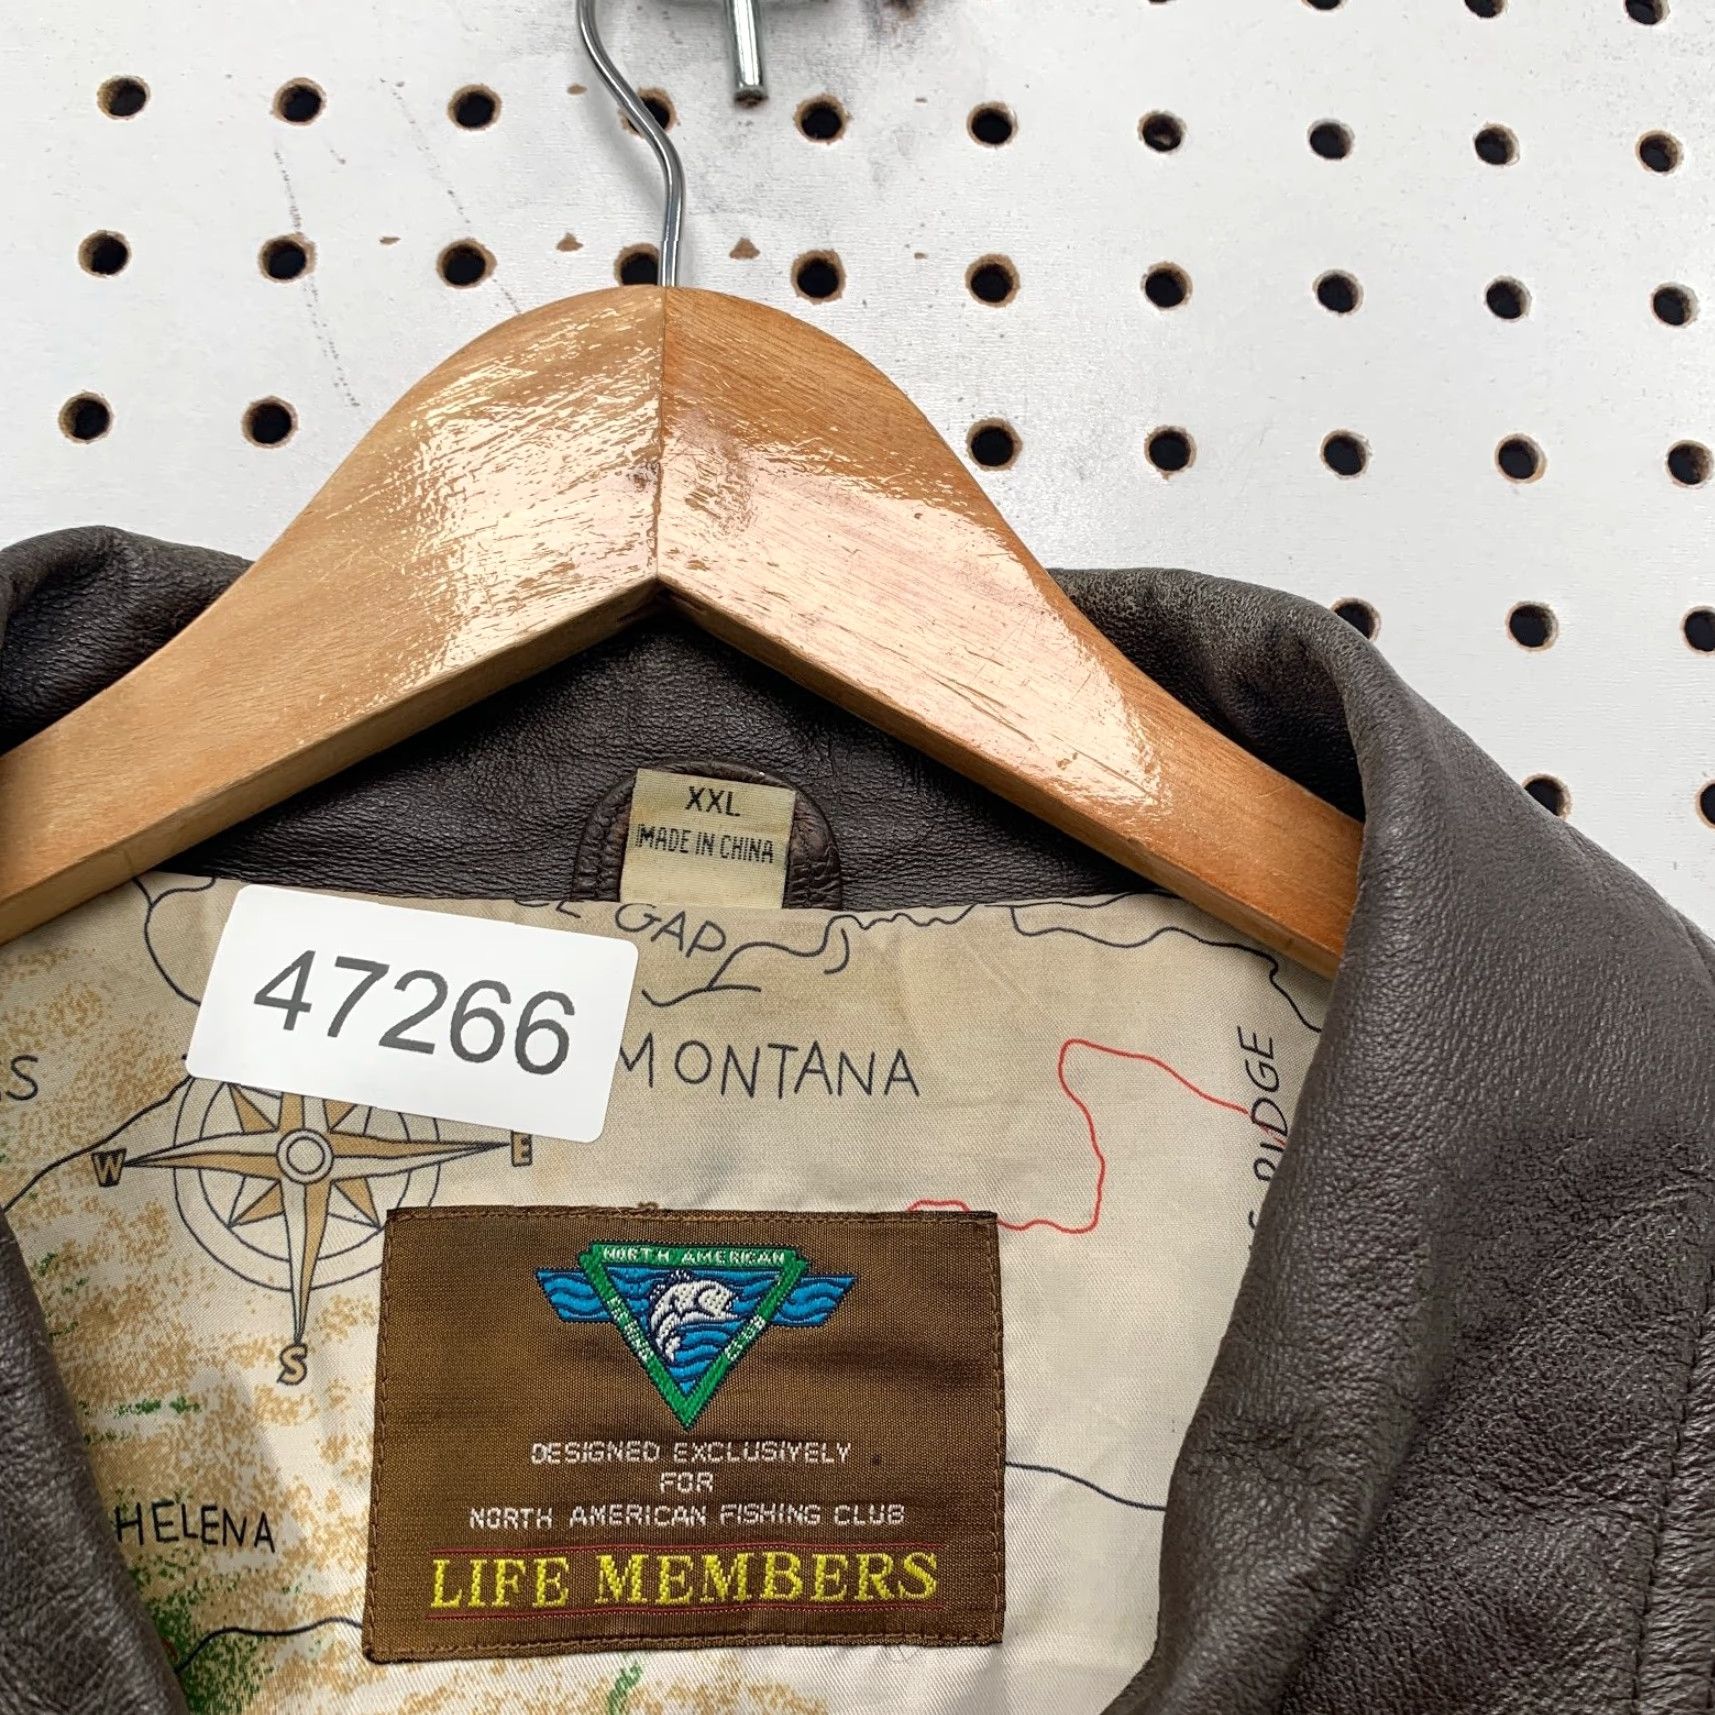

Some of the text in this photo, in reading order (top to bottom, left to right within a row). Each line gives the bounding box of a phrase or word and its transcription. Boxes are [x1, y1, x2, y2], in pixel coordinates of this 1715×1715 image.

[685, 786, 741, 817] XXL
[635, 823, 774, 864] MADE IN CHINA
[614, 902, 727, 959] GAP
[253, 949, 577, 1077] 47266
[619, 1032, 921, 1099] MONTANA
[90, 1148, 128, 1188] W
[603, 1247, 786, 1266] NORTH AMERICAN
[276, 1343, 308, 1386] S
[530, 1440, 853, 1465] DESIGNED EXCLUSIVELY
[659, 1471, 715, 1494] FOR
[114, 1500, 276, 1554] HELENA
[469, 1503, 906, 1531] NORTH AMERICAN FISHING CLUB
[430, 1550, 938, 1610] LIFE MEMBERS
